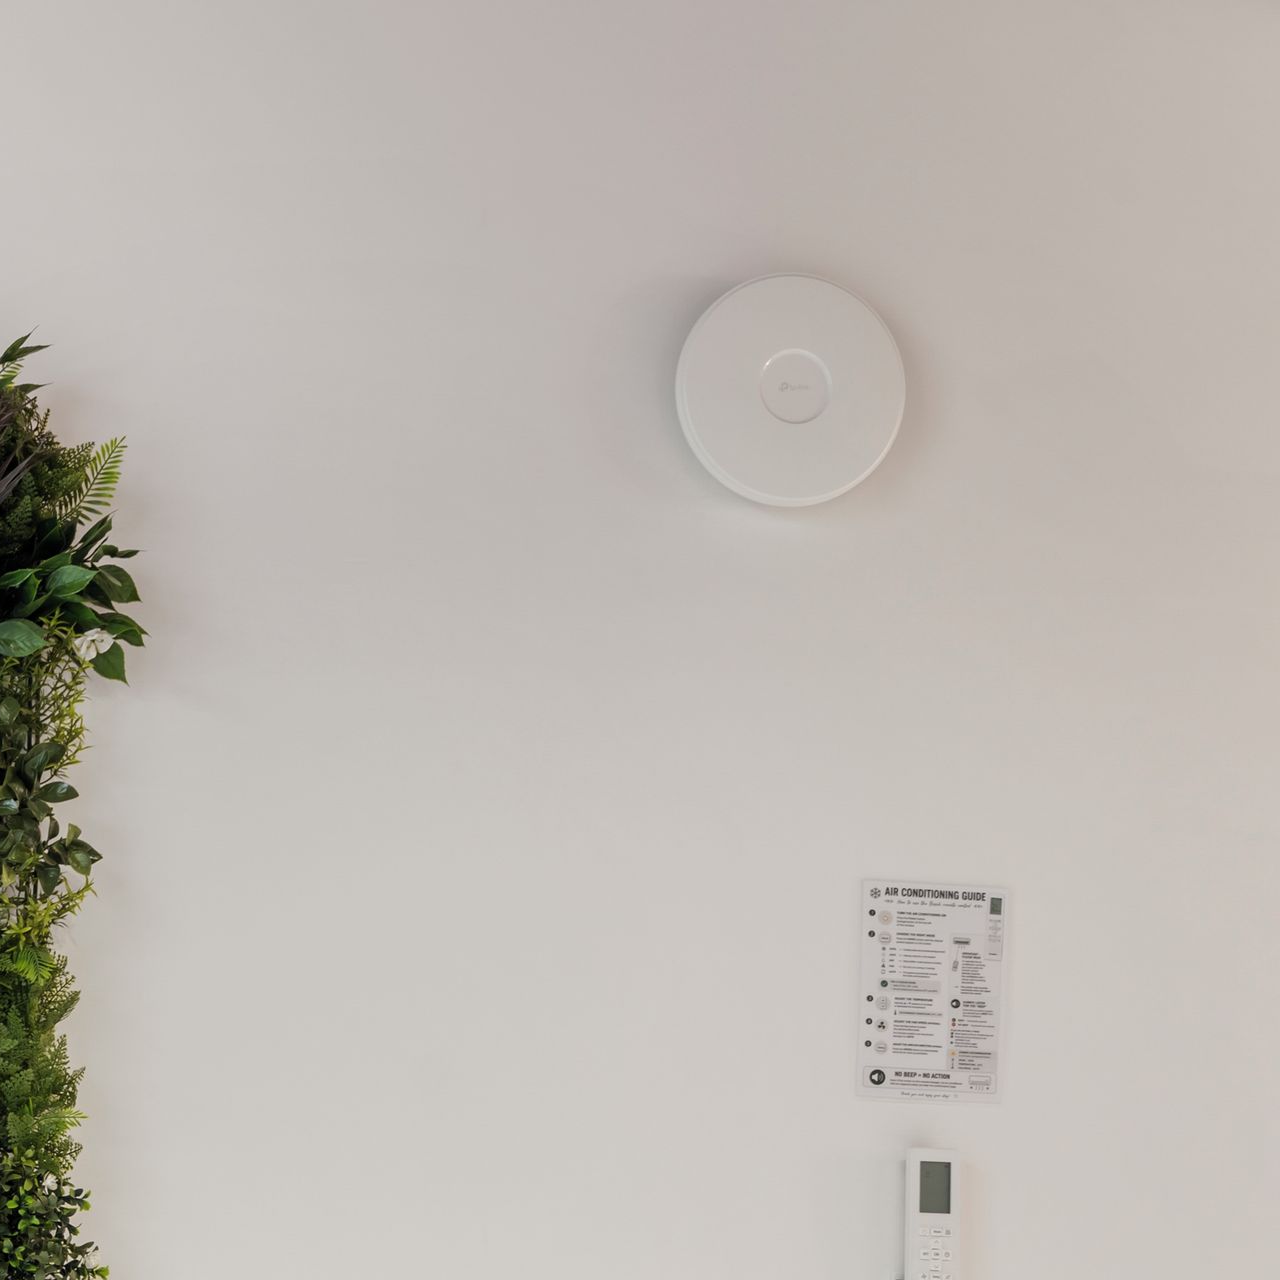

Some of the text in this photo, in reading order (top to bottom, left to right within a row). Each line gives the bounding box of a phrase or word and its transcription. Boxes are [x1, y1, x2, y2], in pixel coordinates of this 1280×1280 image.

[885, 887, 986, 901] AIR CONDITIONING GUIDE
